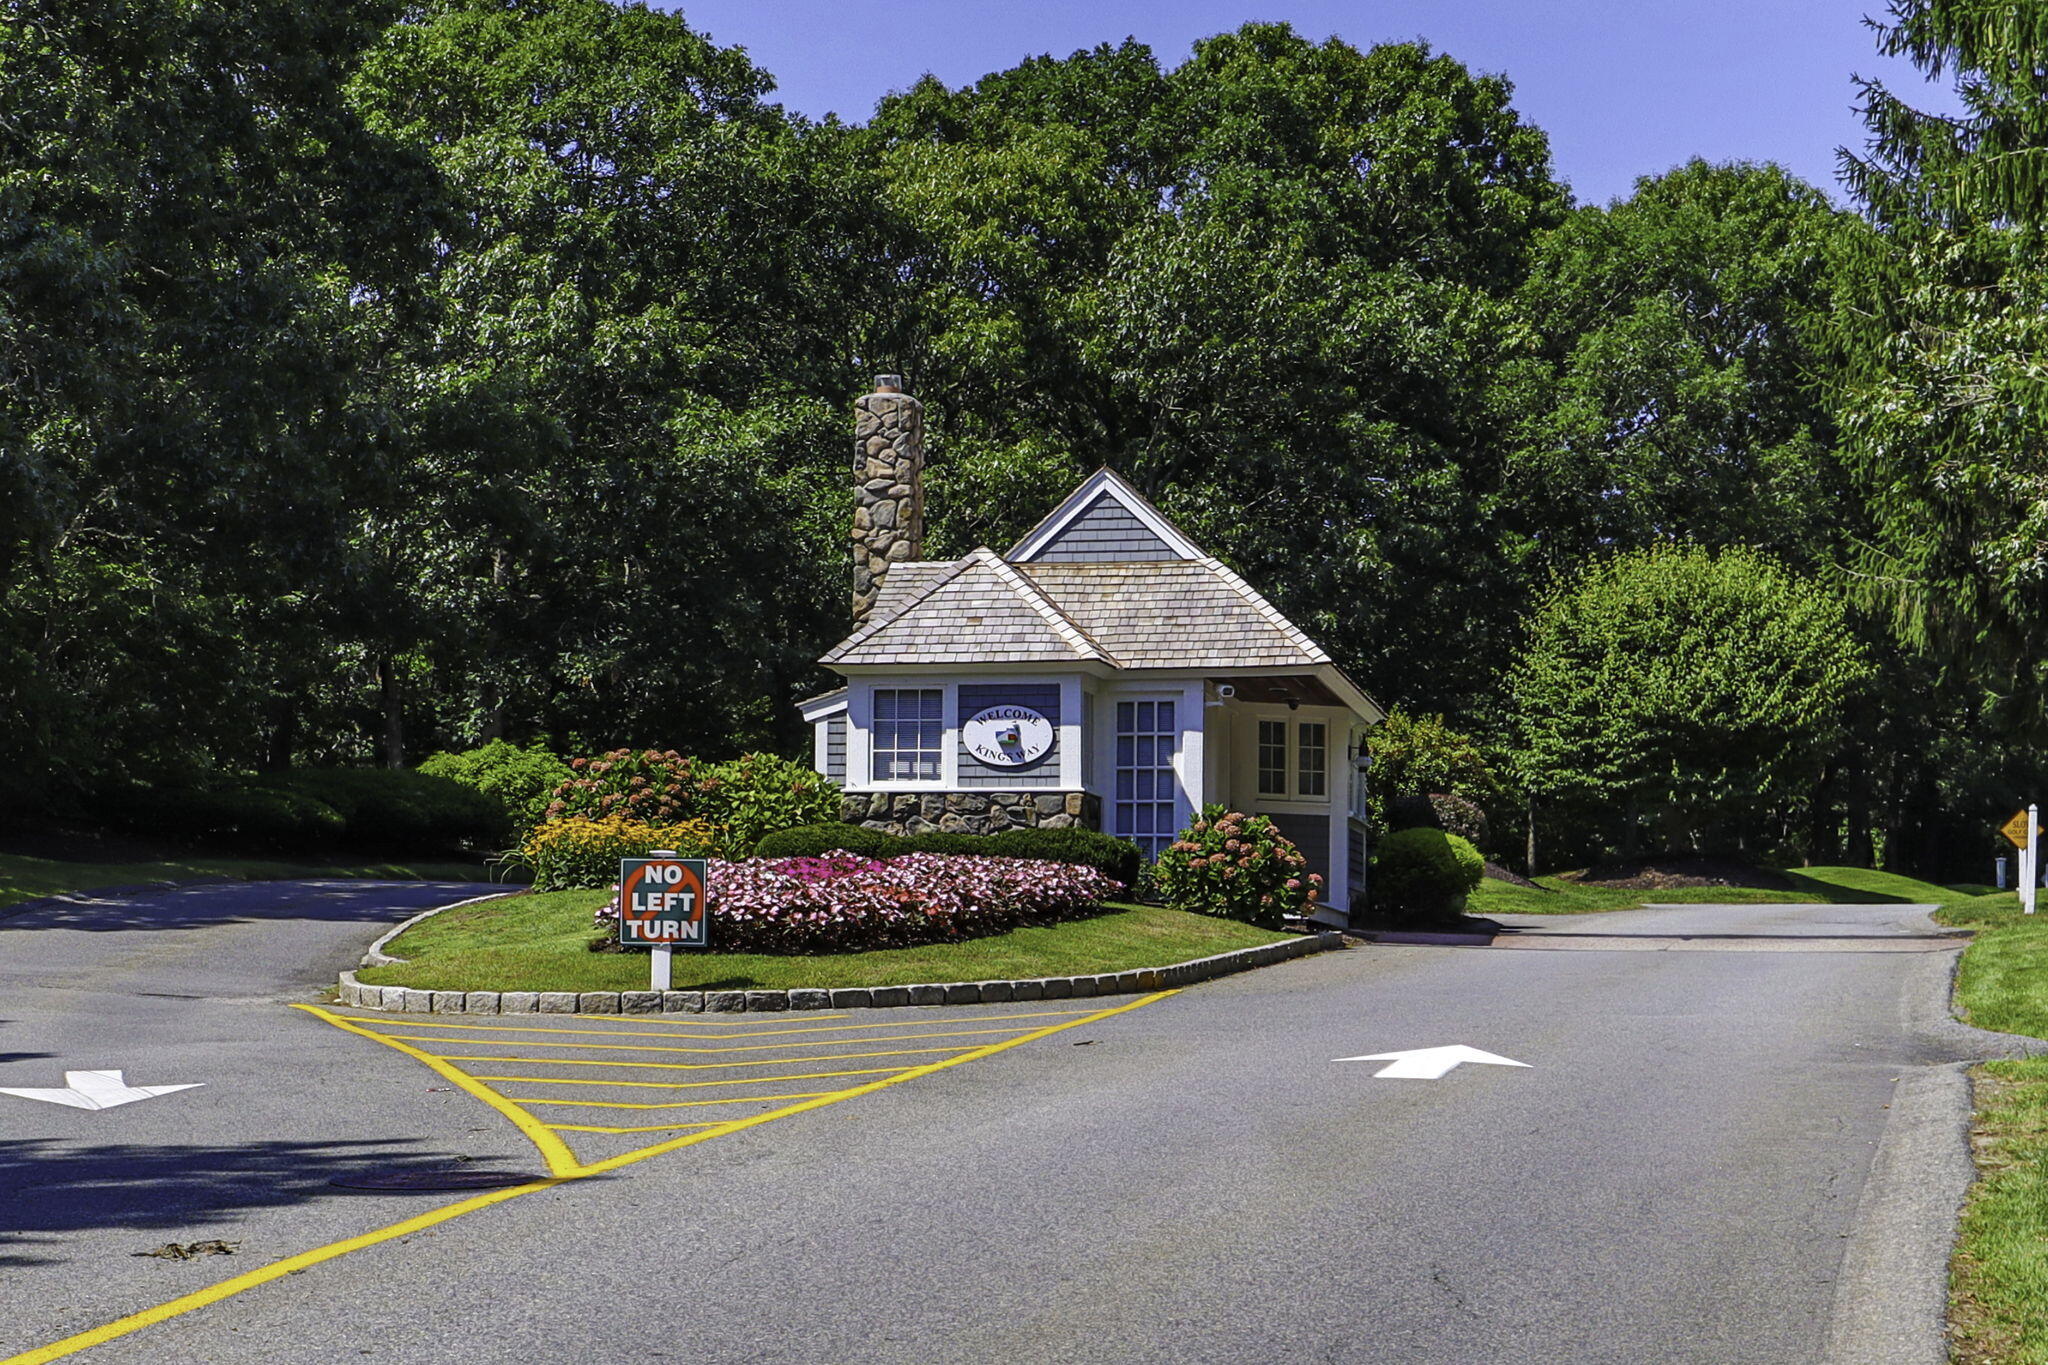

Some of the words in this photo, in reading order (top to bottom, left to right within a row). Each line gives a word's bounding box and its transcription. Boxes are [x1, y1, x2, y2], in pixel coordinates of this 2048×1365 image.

[976, 709, 1041, 727] WELCOME
[2012, 821, 2028, 829] SLO
[645, 865, 682, 884] NO
[632, 892, 695, 912] LEFT
[626, 920, 698, 939] TURN
